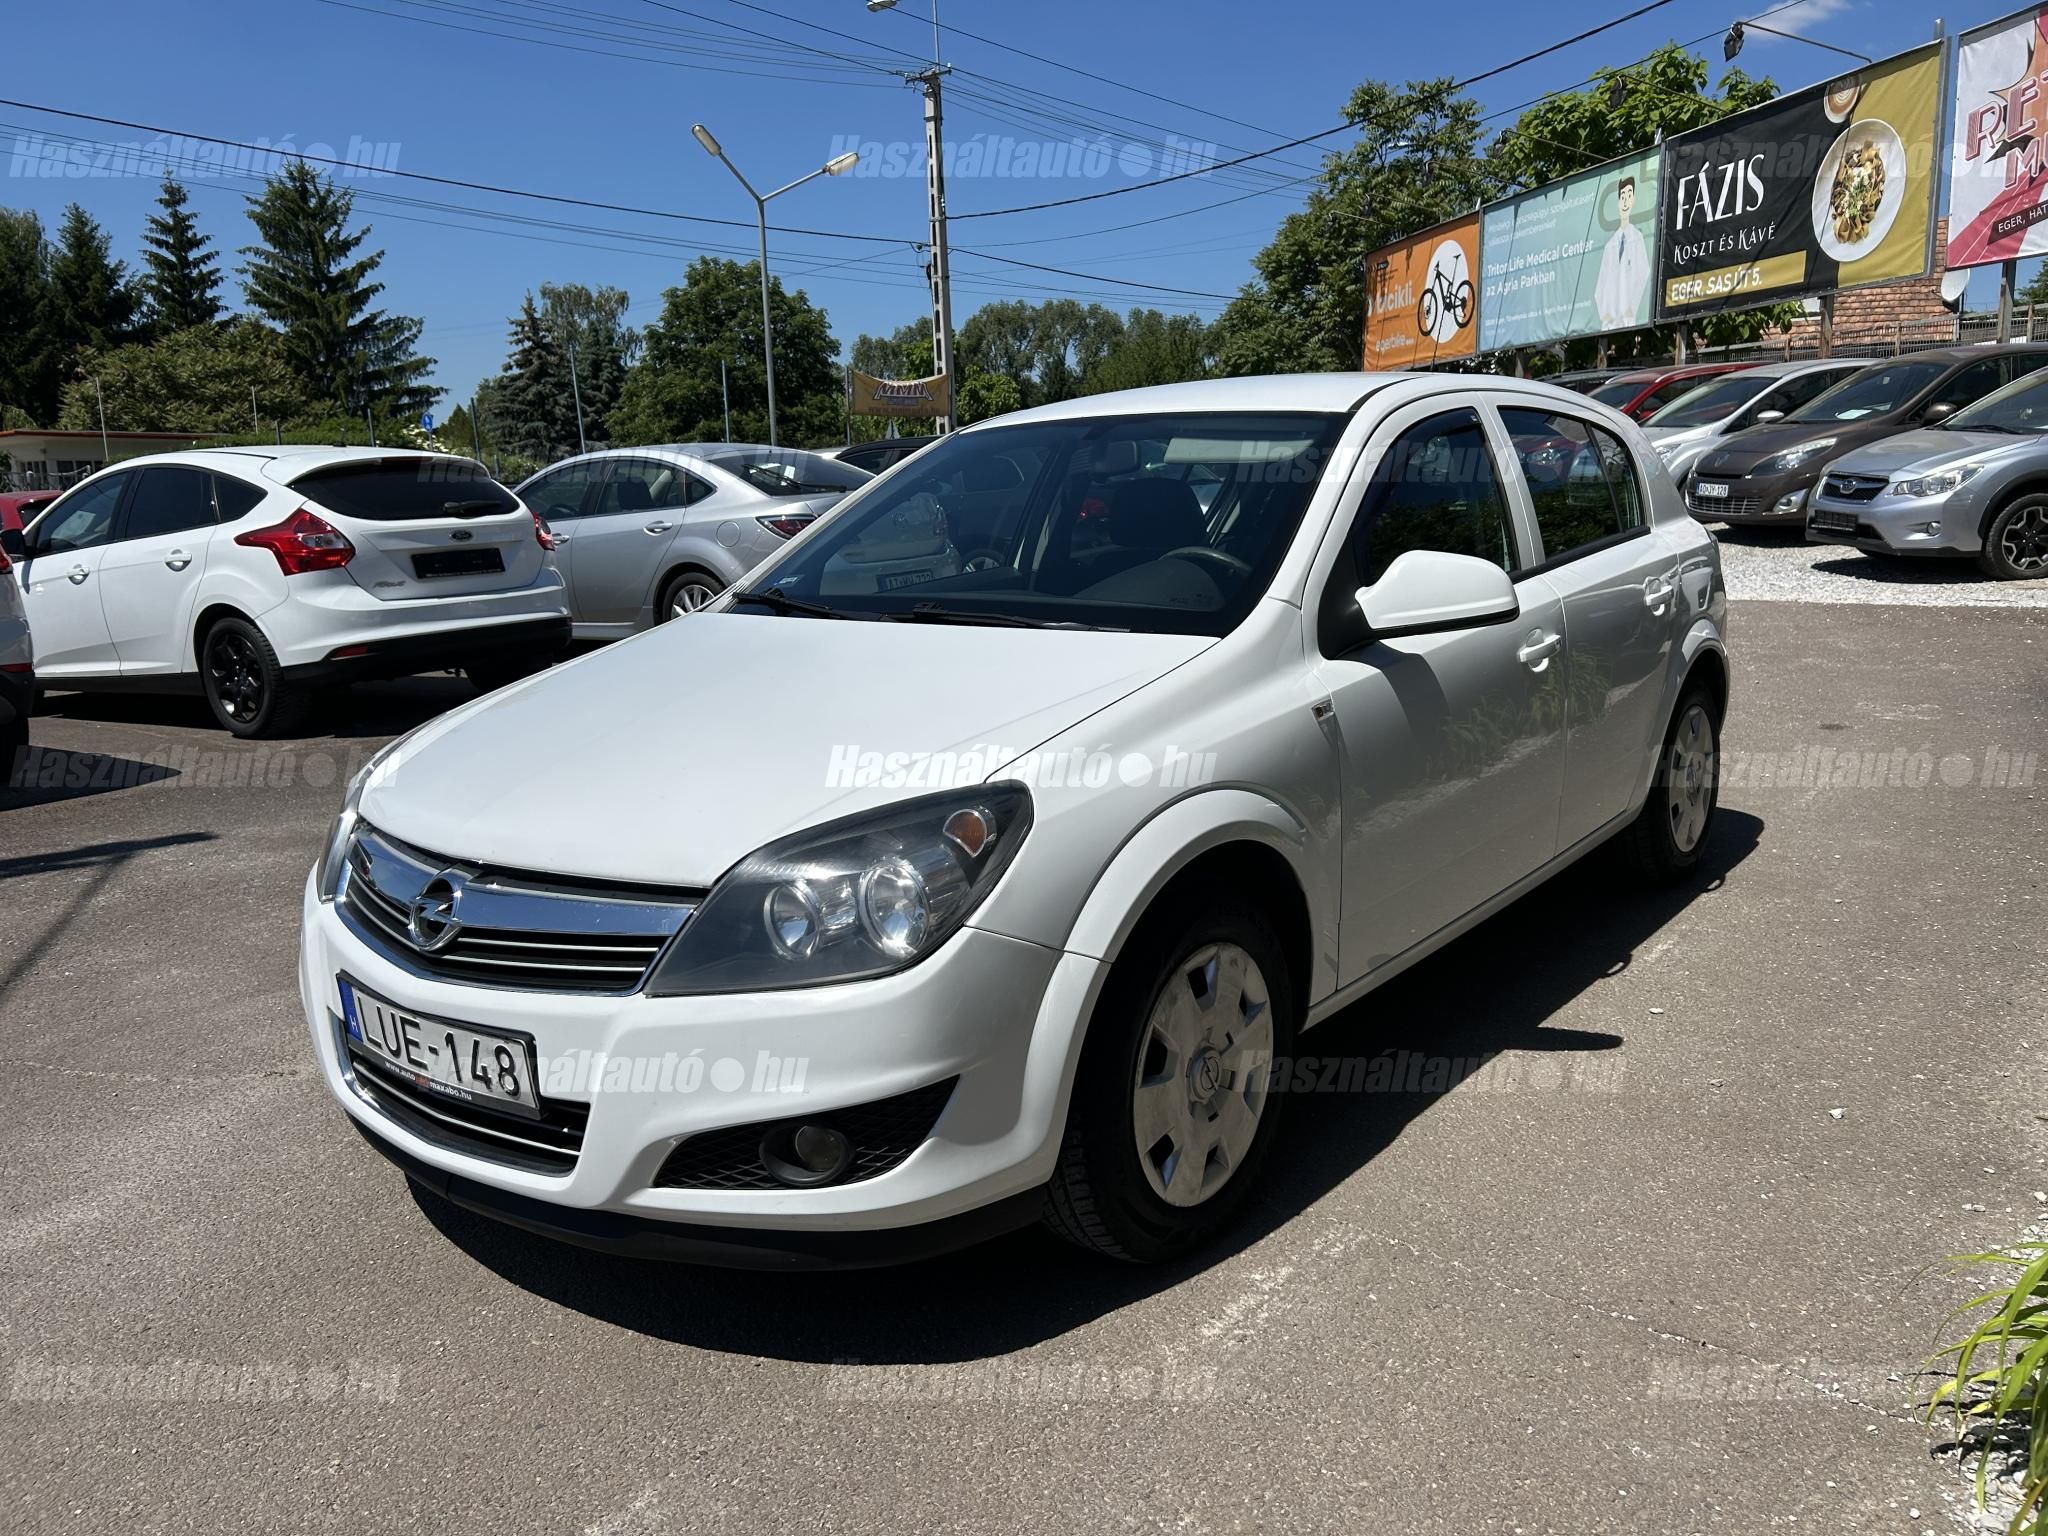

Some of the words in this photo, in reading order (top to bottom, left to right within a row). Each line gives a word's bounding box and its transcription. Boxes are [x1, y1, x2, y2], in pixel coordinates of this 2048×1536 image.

[1676, 153, 1765, 230] FÁZIS
[1998, 214, 2026, 233] EGER,
[1526, 245, 1560, 268] Medical
[1561, 239, 1595, 258] Center
[1674, 239, 1714, 265] KOSZT
[1719, 233, 1734, 251] ÉS
[1738, 221, 1776, 250] KÁVÉ
[1520, 271, 1555, 289] Parkban
[1705, 271, 1732, 295] SAS
[356, 995, 521, 1097] LUE-148
